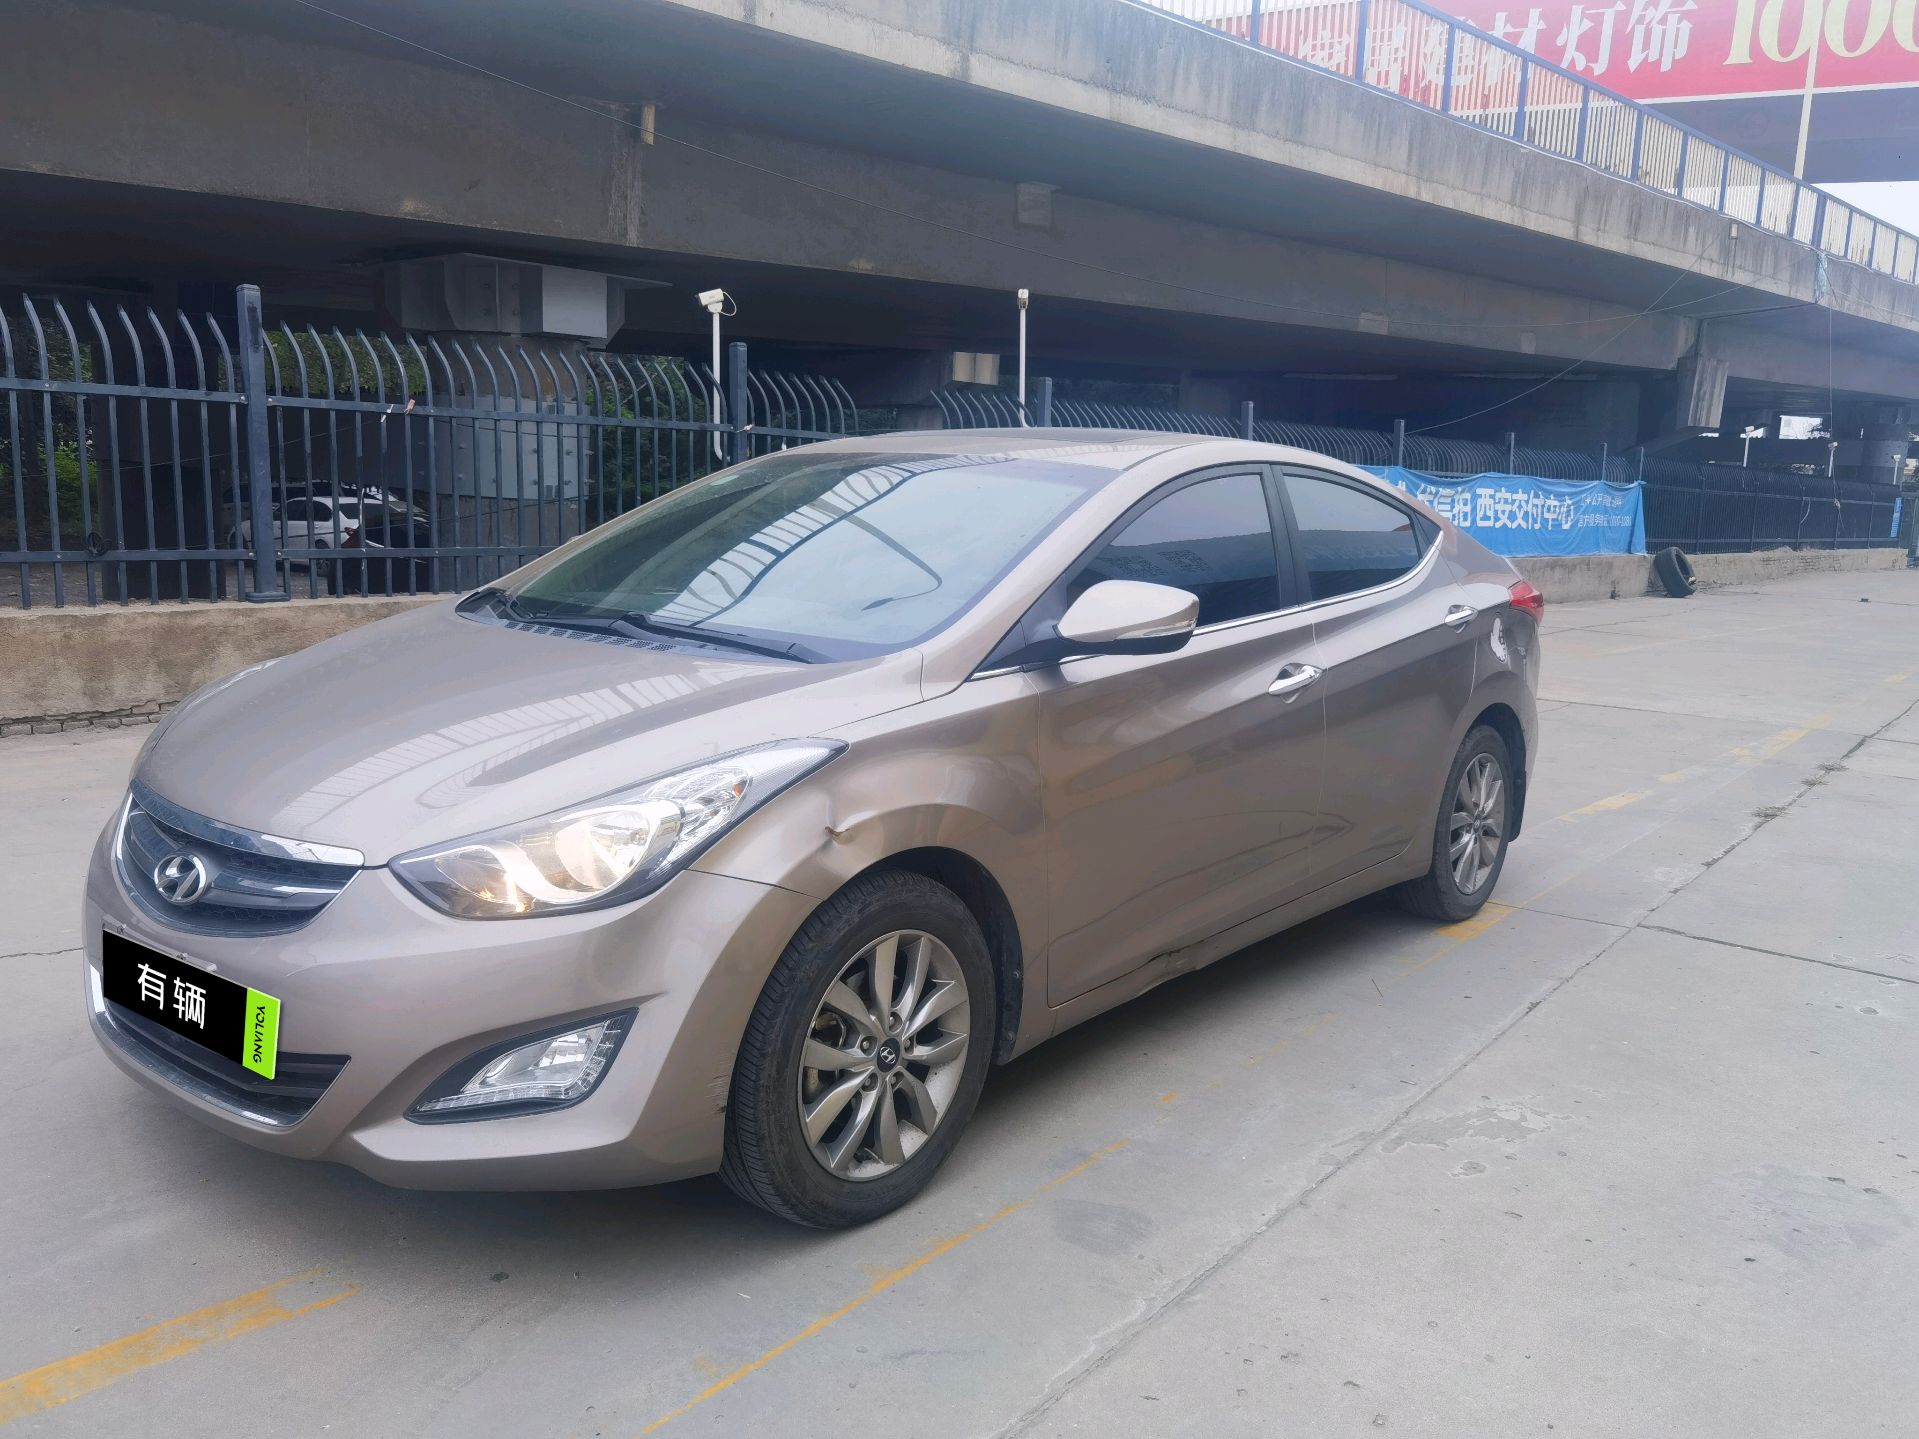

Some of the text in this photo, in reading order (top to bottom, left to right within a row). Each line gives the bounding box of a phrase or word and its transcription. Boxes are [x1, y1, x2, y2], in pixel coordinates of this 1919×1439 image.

[1476, 486, 1575, 531] 西安交付中心
